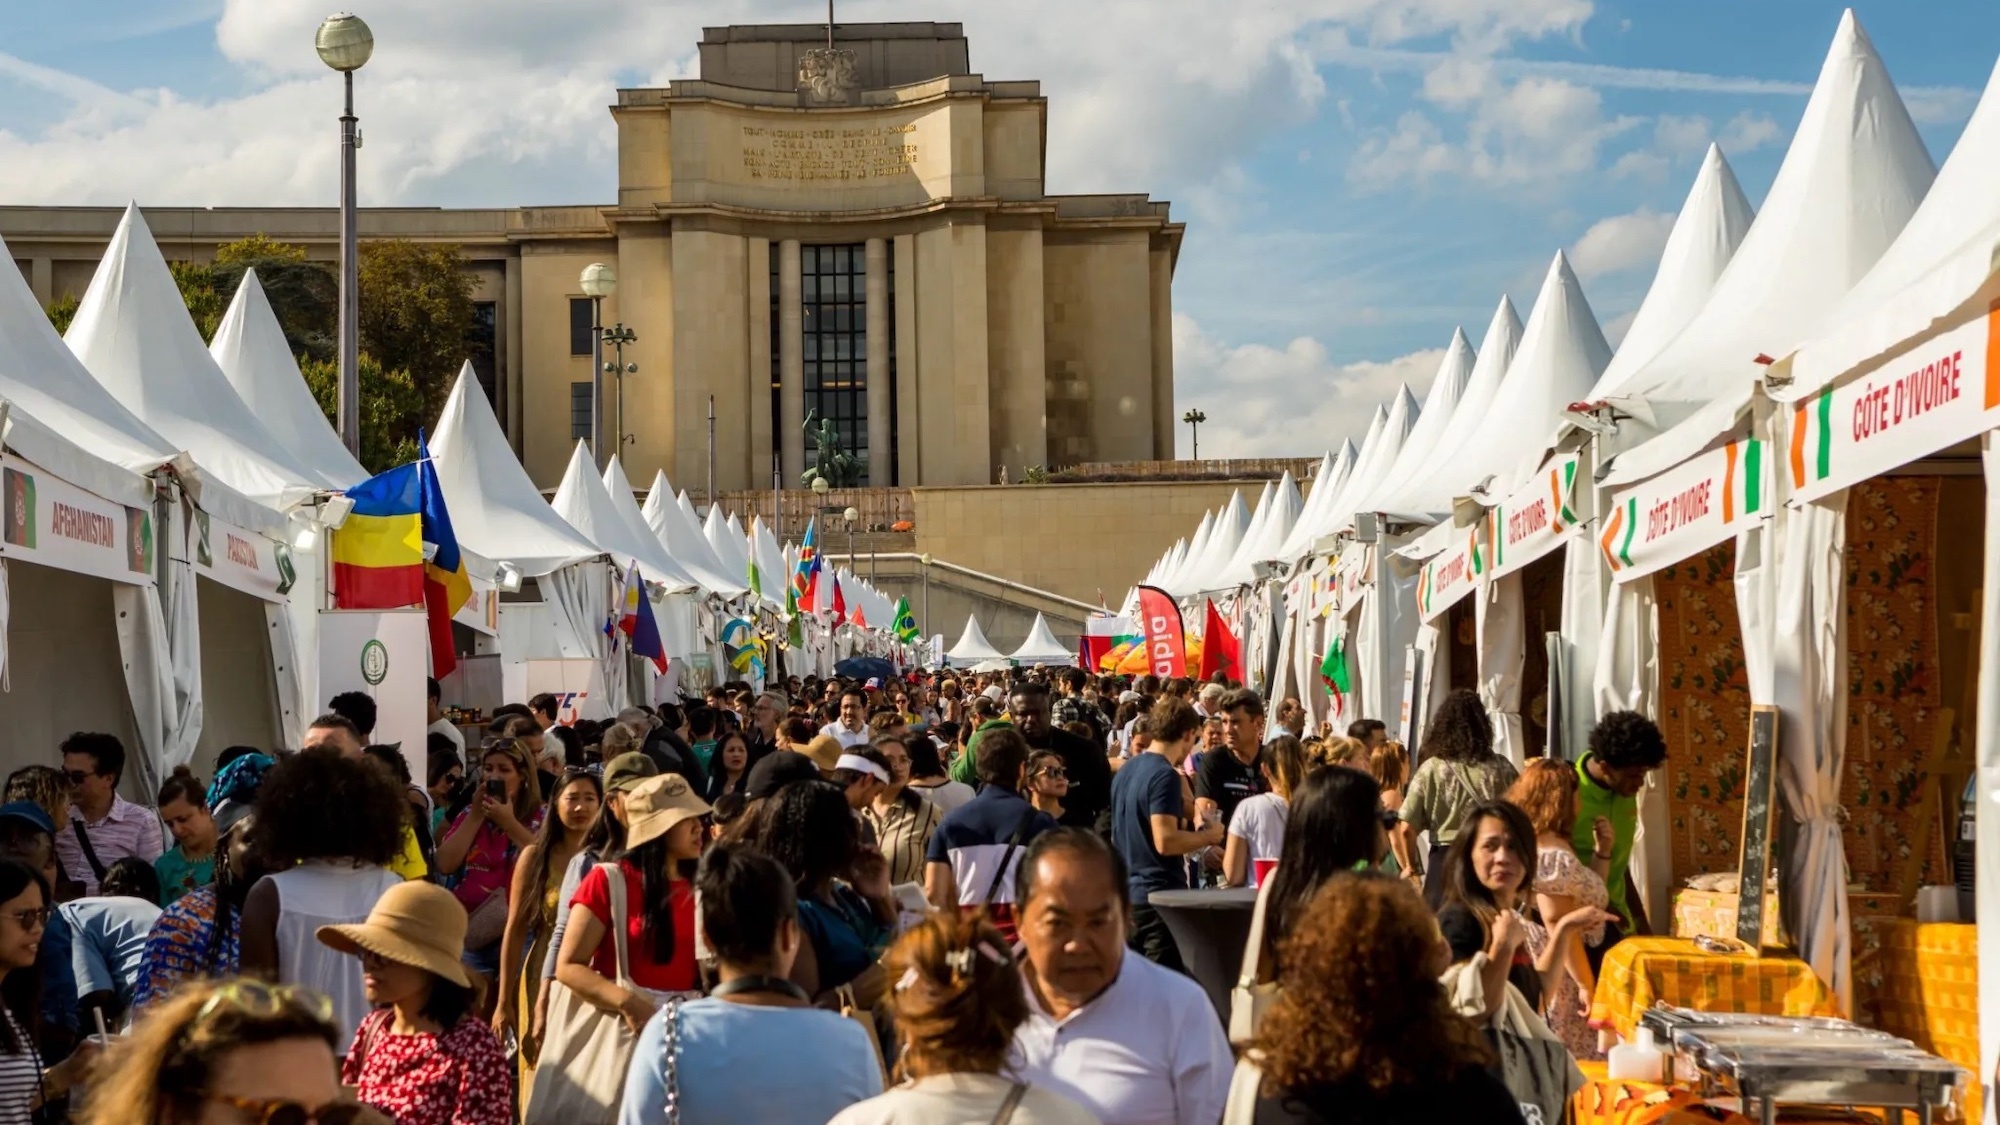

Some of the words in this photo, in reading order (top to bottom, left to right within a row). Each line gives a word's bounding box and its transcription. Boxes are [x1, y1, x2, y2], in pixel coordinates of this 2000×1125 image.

[1853, 382, 1890, 442] CÔTE
[1893, 350, 1962, 425] D'IVOIRE
[53, 501, 114, 548] AFGHANISTAN
[1645, 497, 1669, 543] CÔTE
[1669, 478, 1712, 532] D'IVOIRE
[226, 532, 259, 571] PAKISTAN
